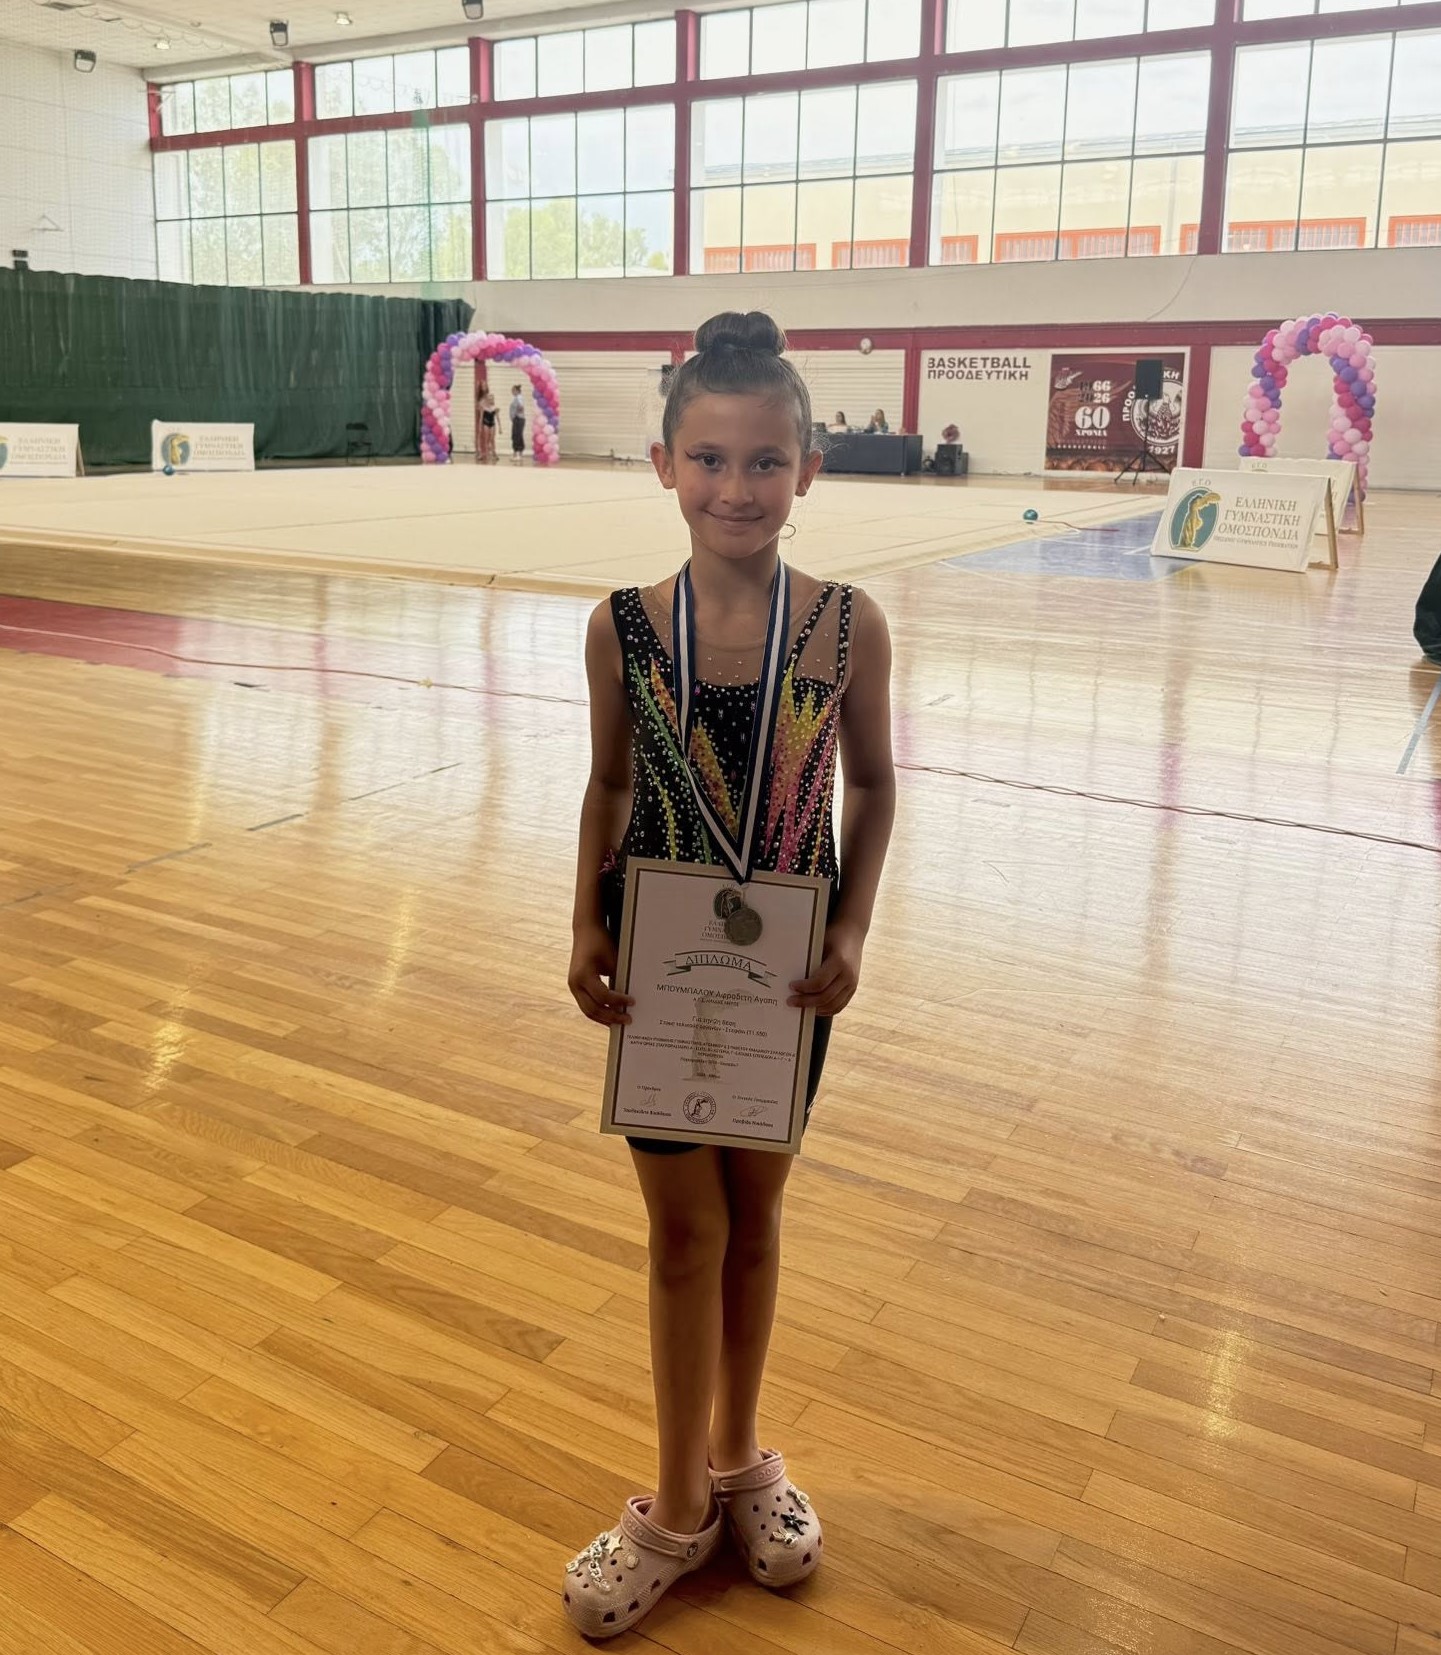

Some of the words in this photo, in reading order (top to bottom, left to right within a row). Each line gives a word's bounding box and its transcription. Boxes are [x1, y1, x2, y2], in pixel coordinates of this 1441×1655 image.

[927, 356, 1032, 369] BASKETBALL
[927, 369, 1029, 381] ΠΡΟΟΔΕΥΤΙΚΗ
[1075, 405, 1110, 429] 60
[1148, 445, 1176, 455] 1927
[1235, 496, 1297, 512] ΕΛΛΗΝΙΚΗ
[1224, 510, 1301, 527] ΓΥΜΝΑΣΤΙΚΗ
[1218, 522, 1299, 541] ΟΜΟΣΠΟΝΔΙΑ
[685, 954, 752, 971] ΔΙΠΛΩΜΑ
